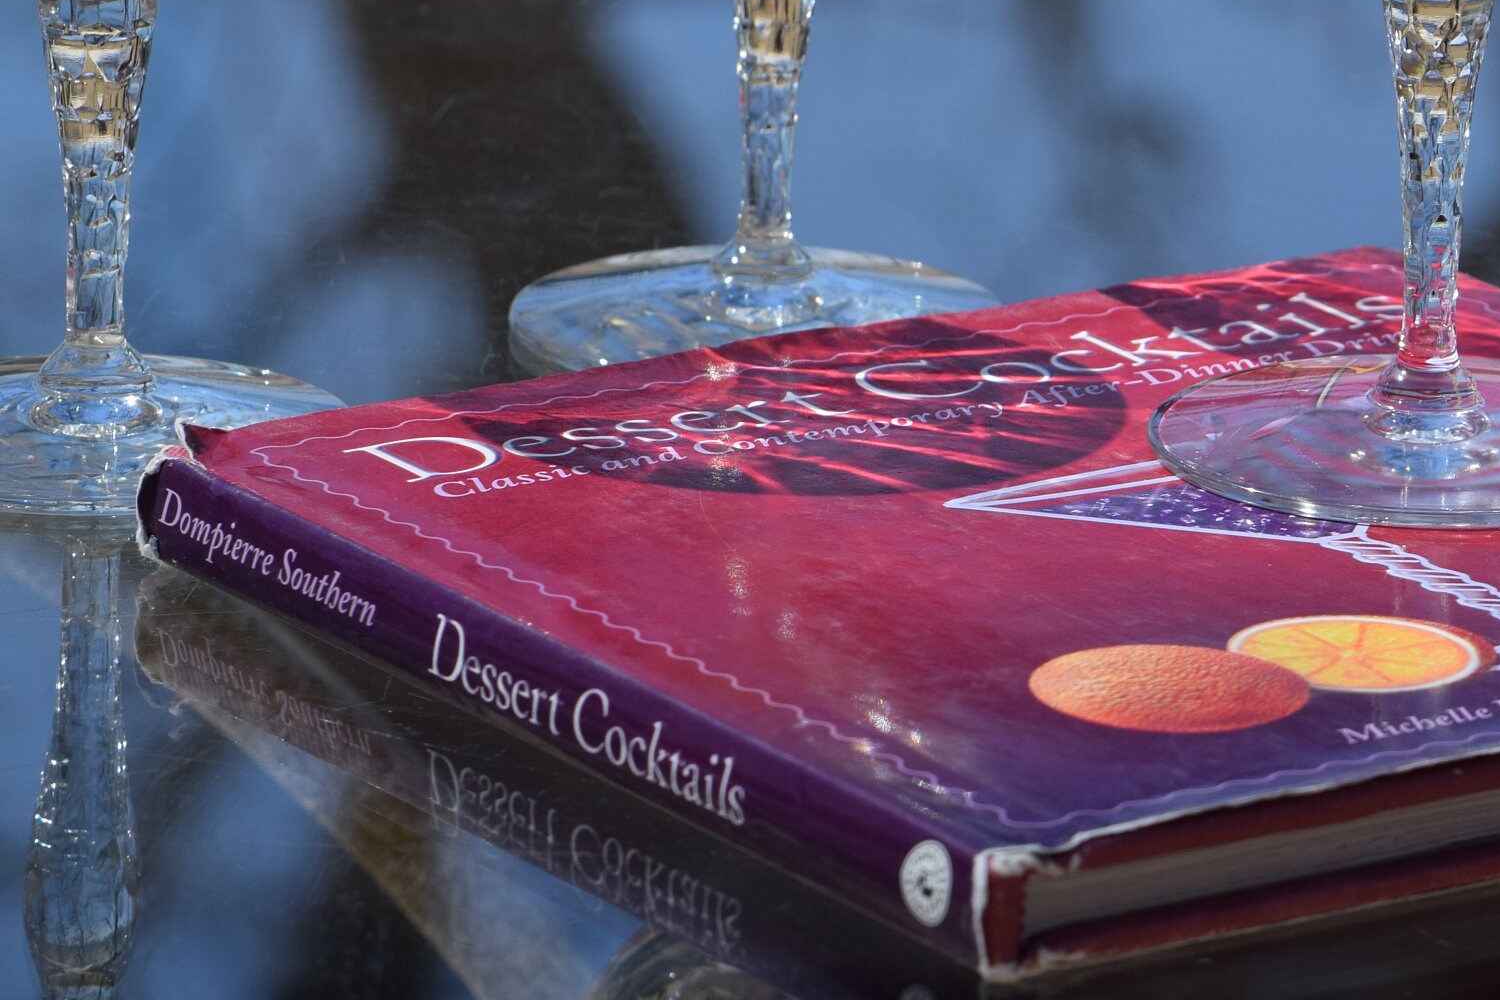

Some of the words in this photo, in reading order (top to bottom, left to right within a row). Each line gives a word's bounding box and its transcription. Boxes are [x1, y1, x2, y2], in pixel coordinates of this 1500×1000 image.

[342, 390, 856, 483] Dessert
[854, 290, 1405, 399] Cocktails
[432, 461, 592, 500] Classic
[601, 445, 688, 473] and
[692, 399, 1004, 456] Contemporary
[1017, 349, 1295, 409] After-Dinner
[1300, 331, 1404, 357] Drin
[158, 488, 275, 576] Dompierre
[277, 547, 378, 627] Southern
[427, 612, 562, 736] Dessert
[571, 687, 748, 827] Cocktails
[1337, 704, 1493, 746] Michelle
